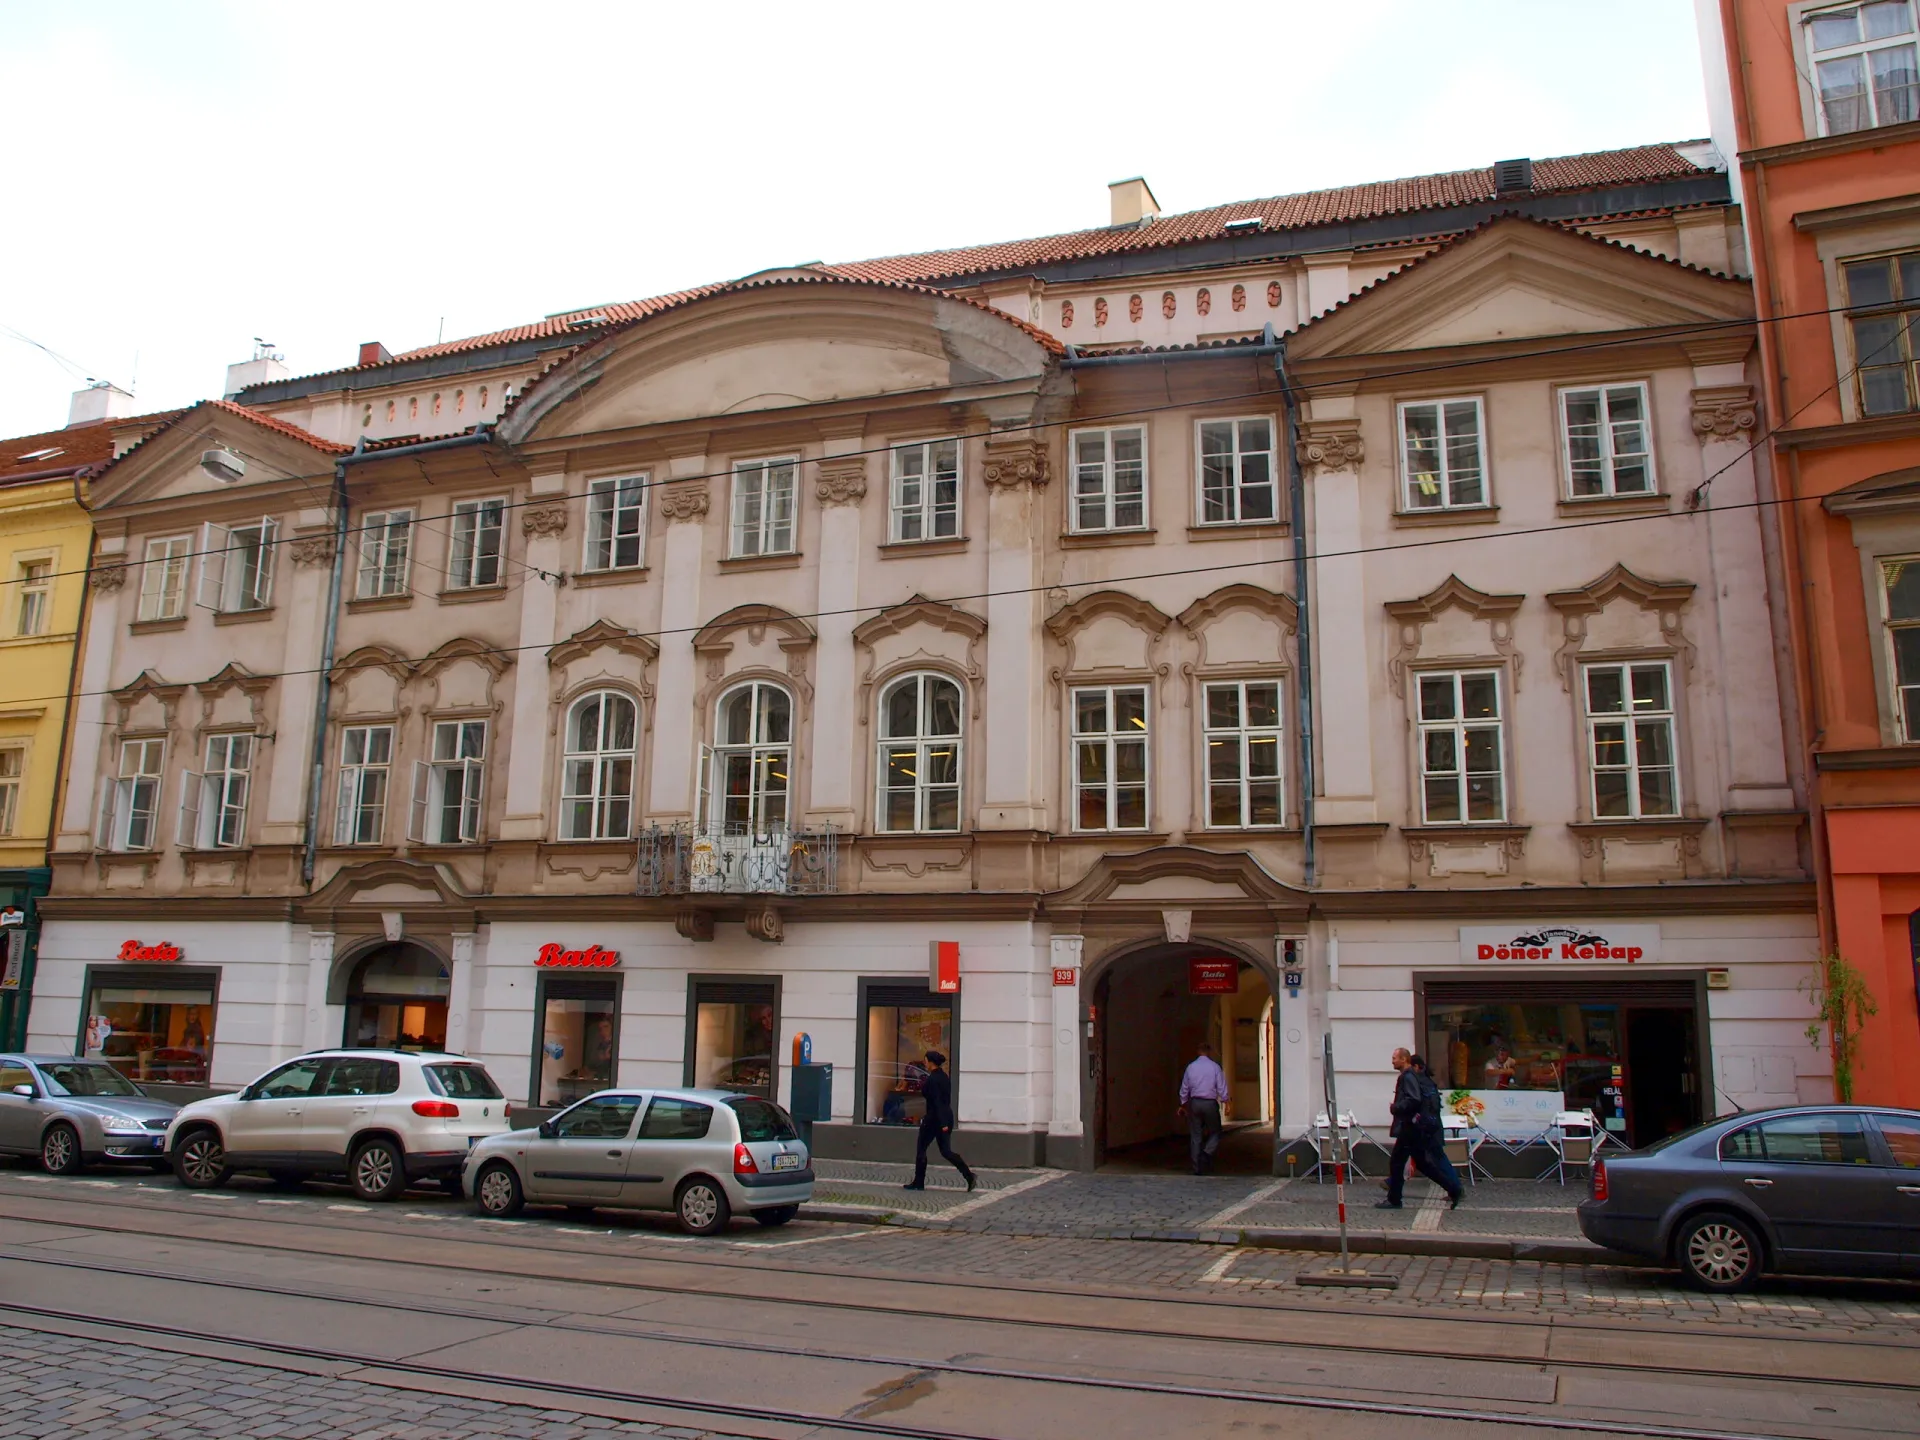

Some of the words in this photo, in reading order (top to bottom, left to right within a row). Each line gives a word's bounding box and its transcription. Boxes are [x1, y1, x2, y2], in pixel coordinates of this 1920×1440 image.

[1477, 943, 1552, 960] Döner
[1561, 943, 1643, 963] Kebap
[1056, 970, 1072, 980] 939
[1287, 974, 1299, 984] 20
[804, 1041, 811, 1057] P
